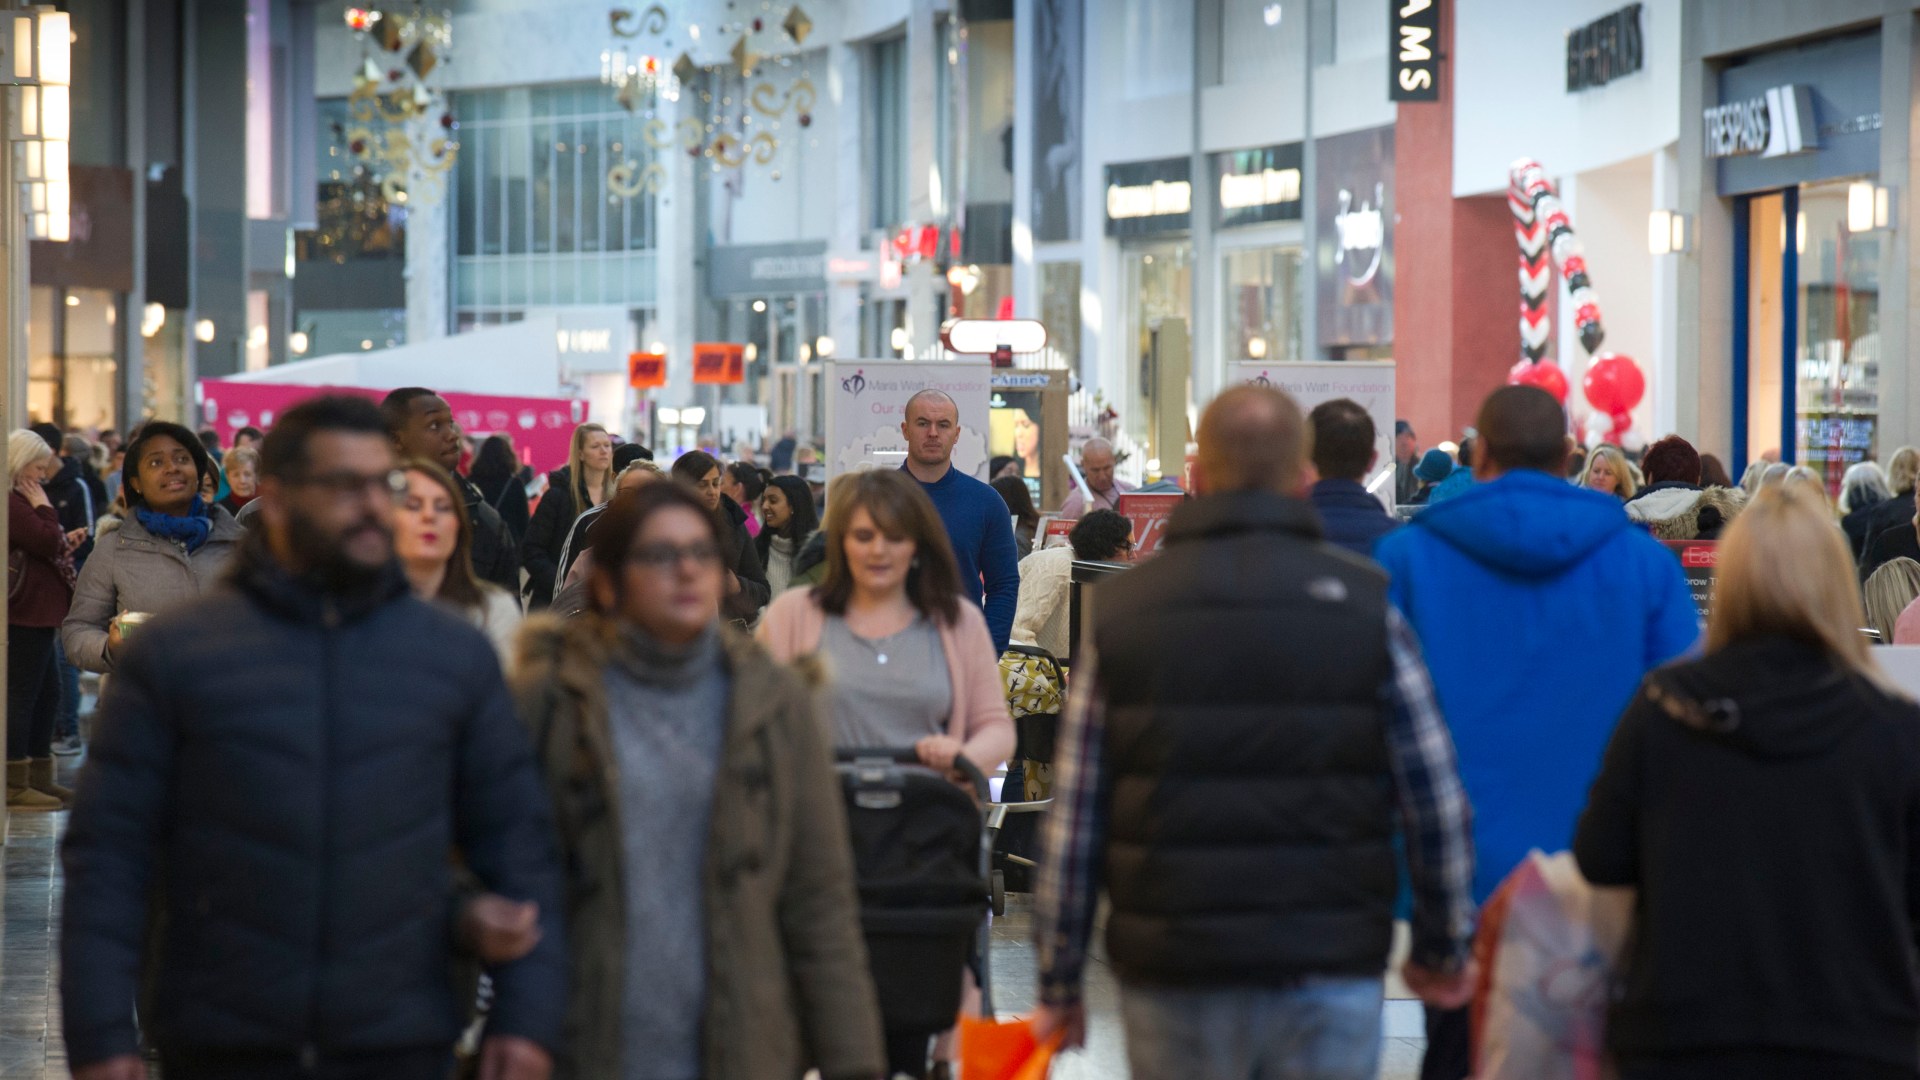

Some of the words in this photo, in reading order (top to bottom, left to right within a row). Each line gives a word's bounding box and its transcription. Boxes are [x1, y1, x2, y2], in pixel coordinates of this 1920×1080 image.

[1703, 97, 1767, 159] TRESPASS
[868, 380, 898, 391] Maria
[901, 380, 925, 391] Watt
[928, 380, 987, 391] Foundation
[1306, 382, 1330, 393] Watt
[1333, 382, 1391, 393] Foundation
[871, 402, 895, 414] Our
[864, 444, 898, 455] Fund
